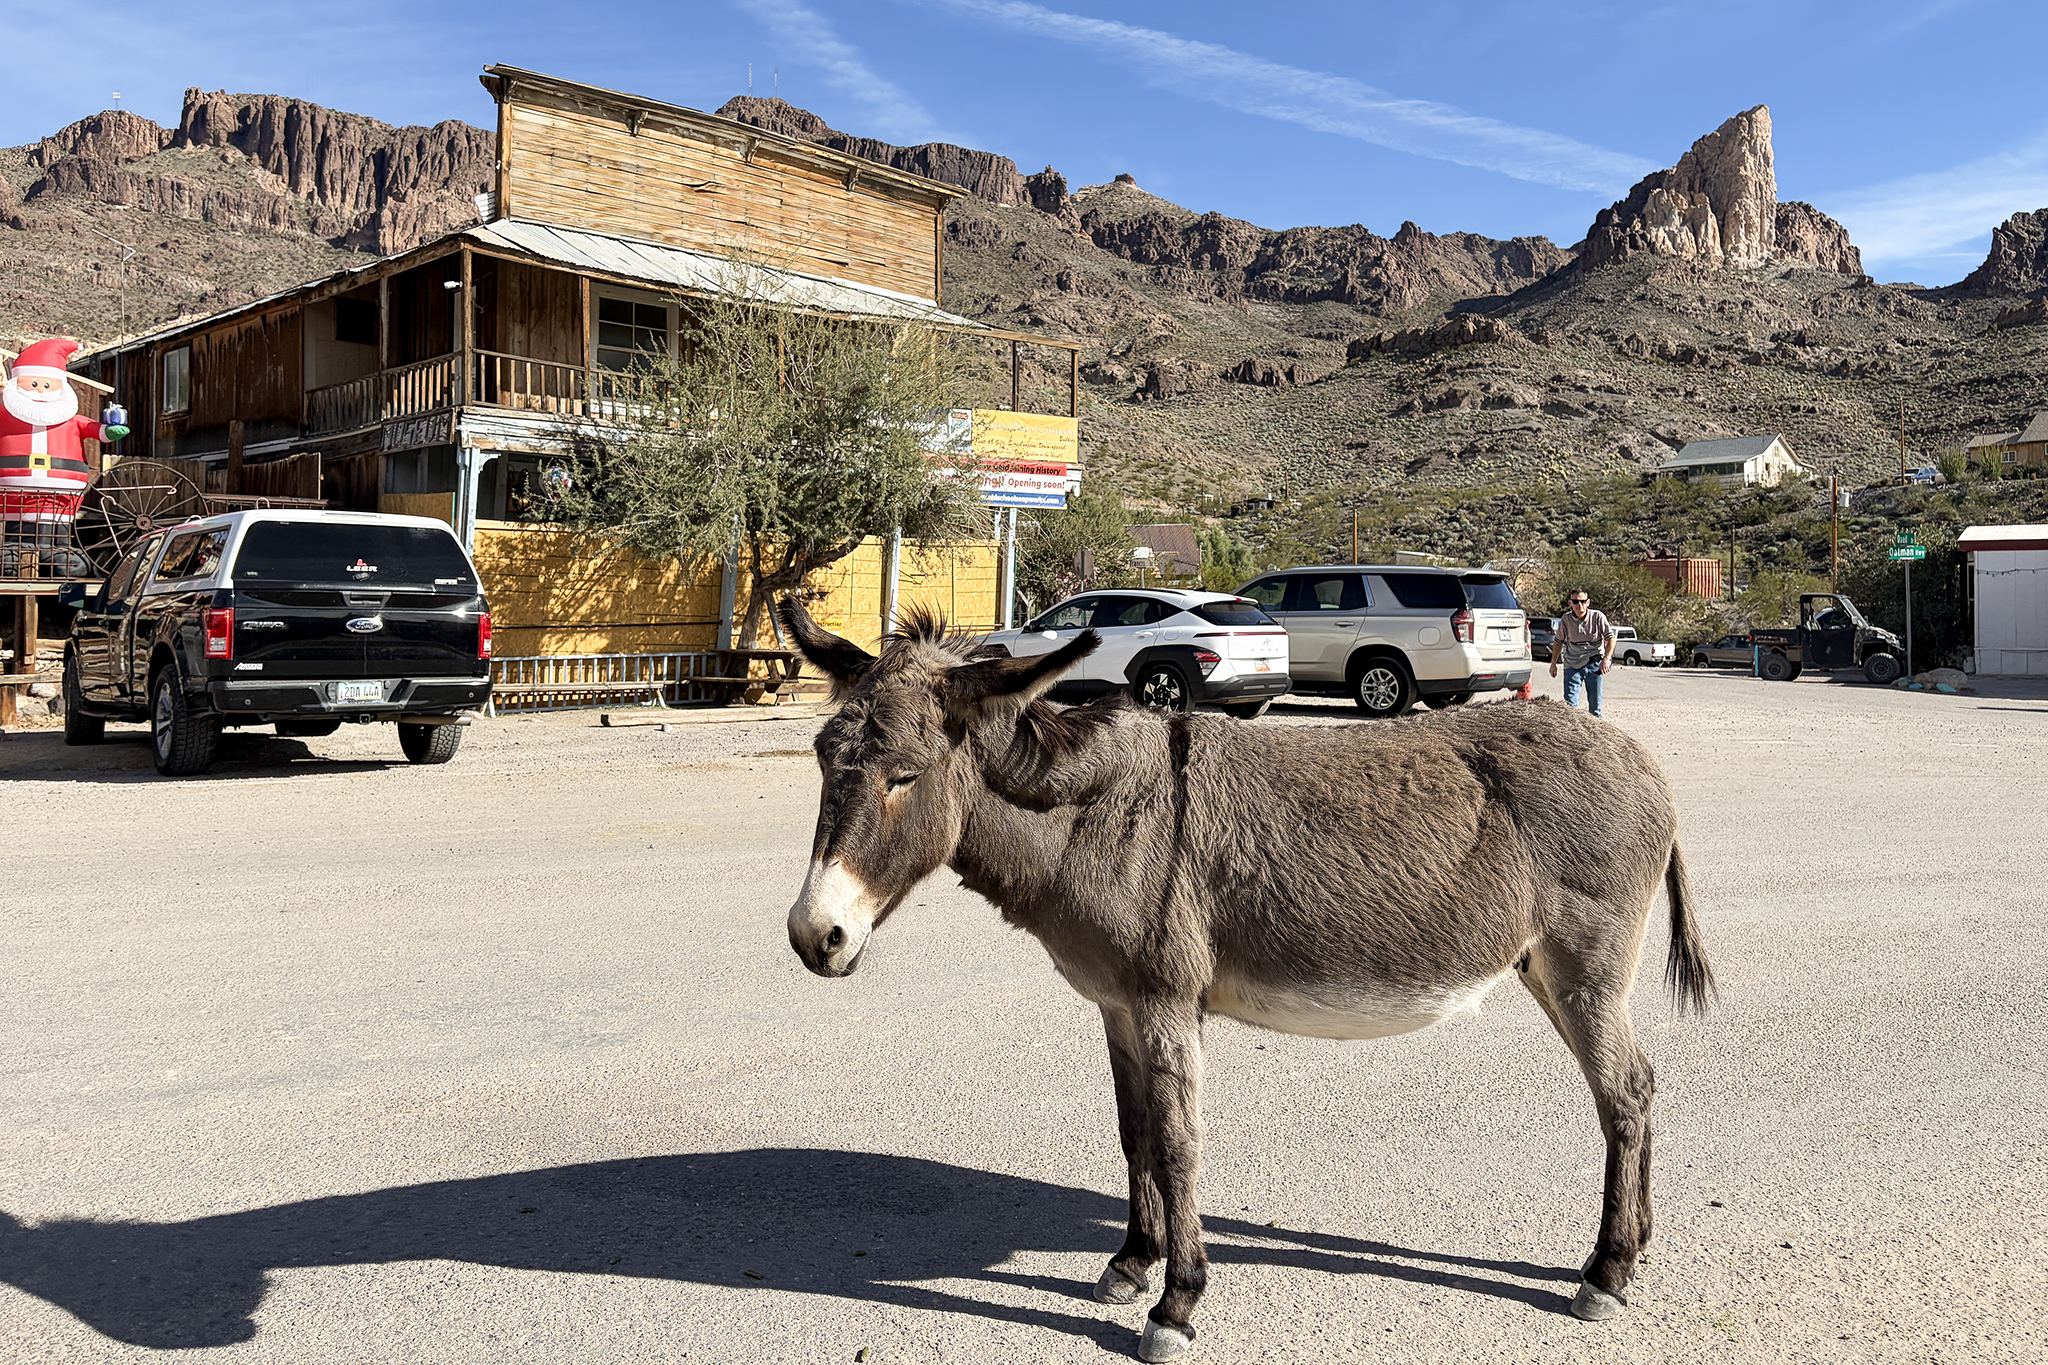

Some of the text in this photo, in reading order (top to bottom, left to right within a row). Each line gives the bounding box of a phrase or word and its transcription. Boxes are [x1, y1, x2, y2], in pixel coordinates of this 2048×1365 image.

[1036, 466, 1061, 476] History
[1008, 478, 1042, 490] Opening
[1043, 481, 1066, 490] soon!
[1889, 547, 1925, 557] Oatman Hwy
